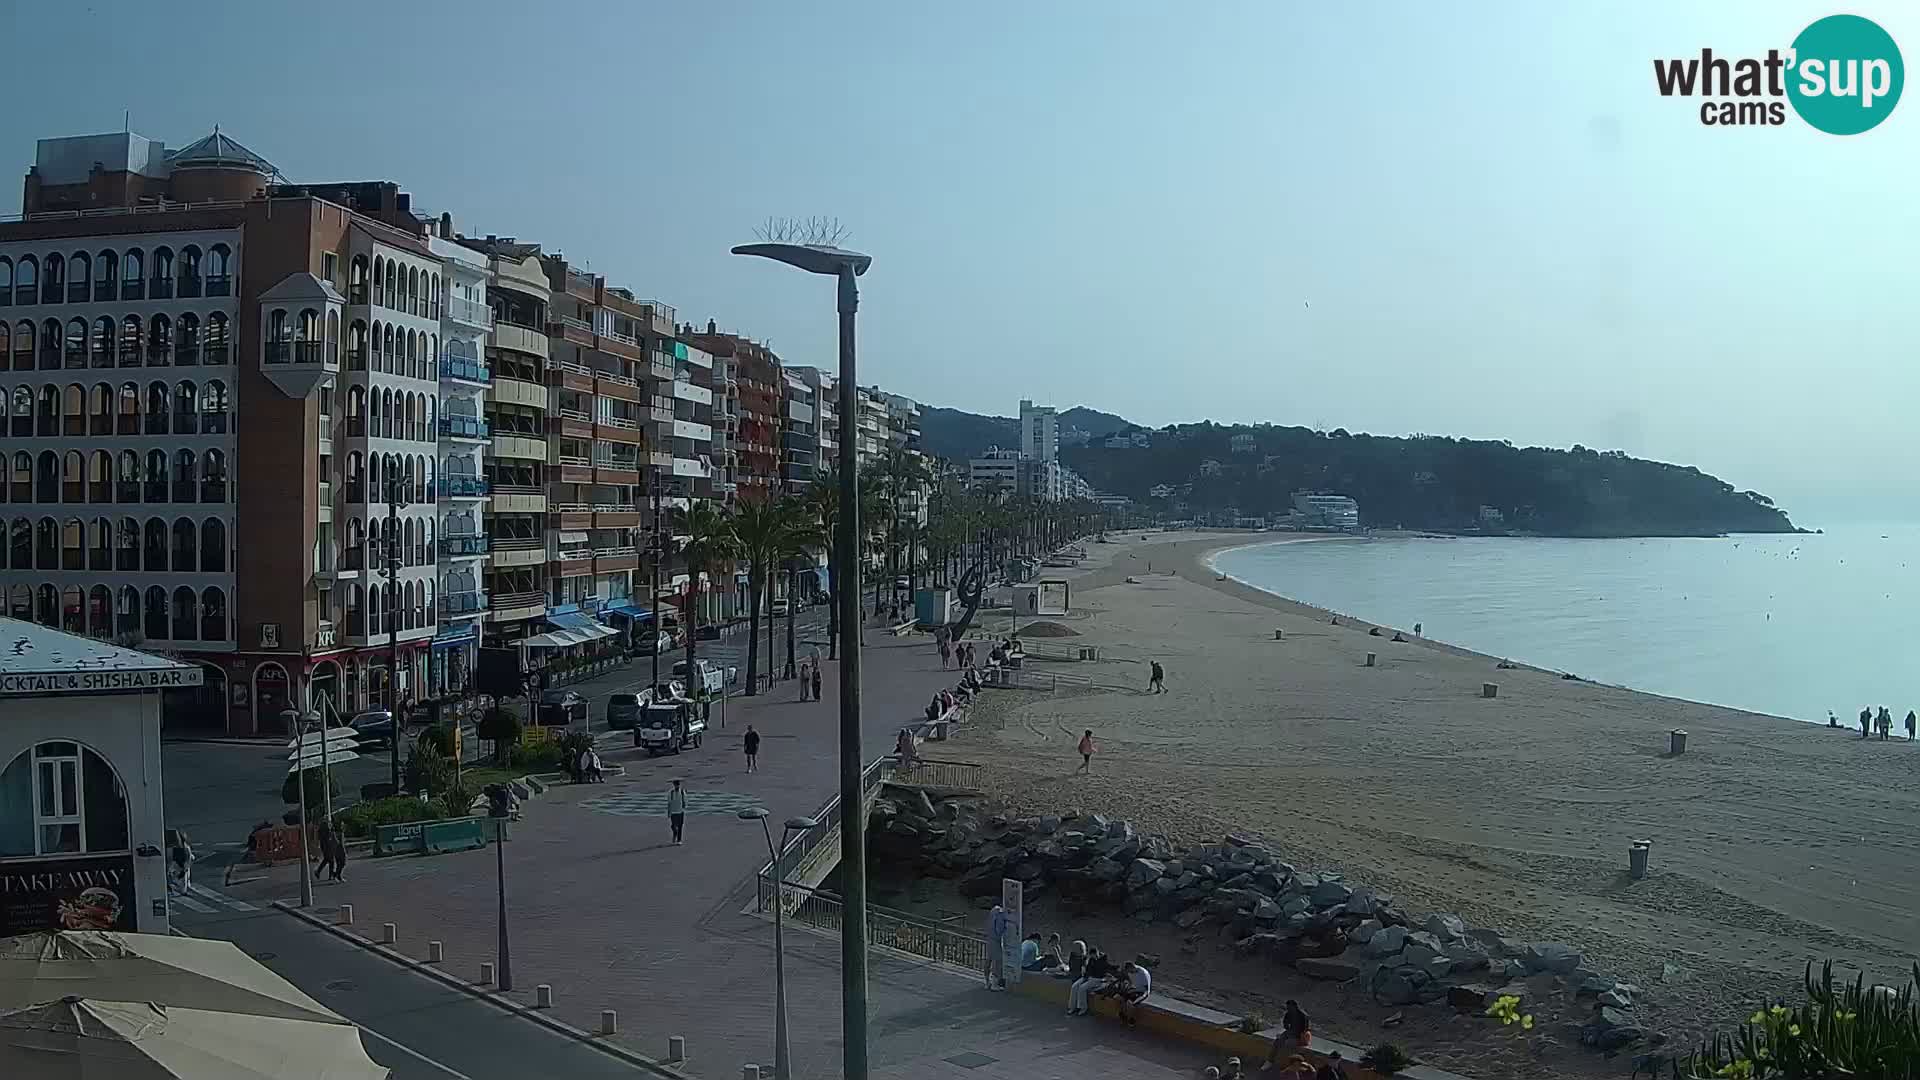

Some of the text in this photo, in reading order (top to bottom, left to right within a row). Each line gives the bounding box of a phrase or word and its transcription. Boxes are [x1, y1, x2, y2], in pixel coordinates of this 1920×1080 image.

[318, 630, 337, 647] KFC
[0, 671, 182, 691] CKTAIL & SHISHA BAR
[263, 668, 285, 679] KFC
